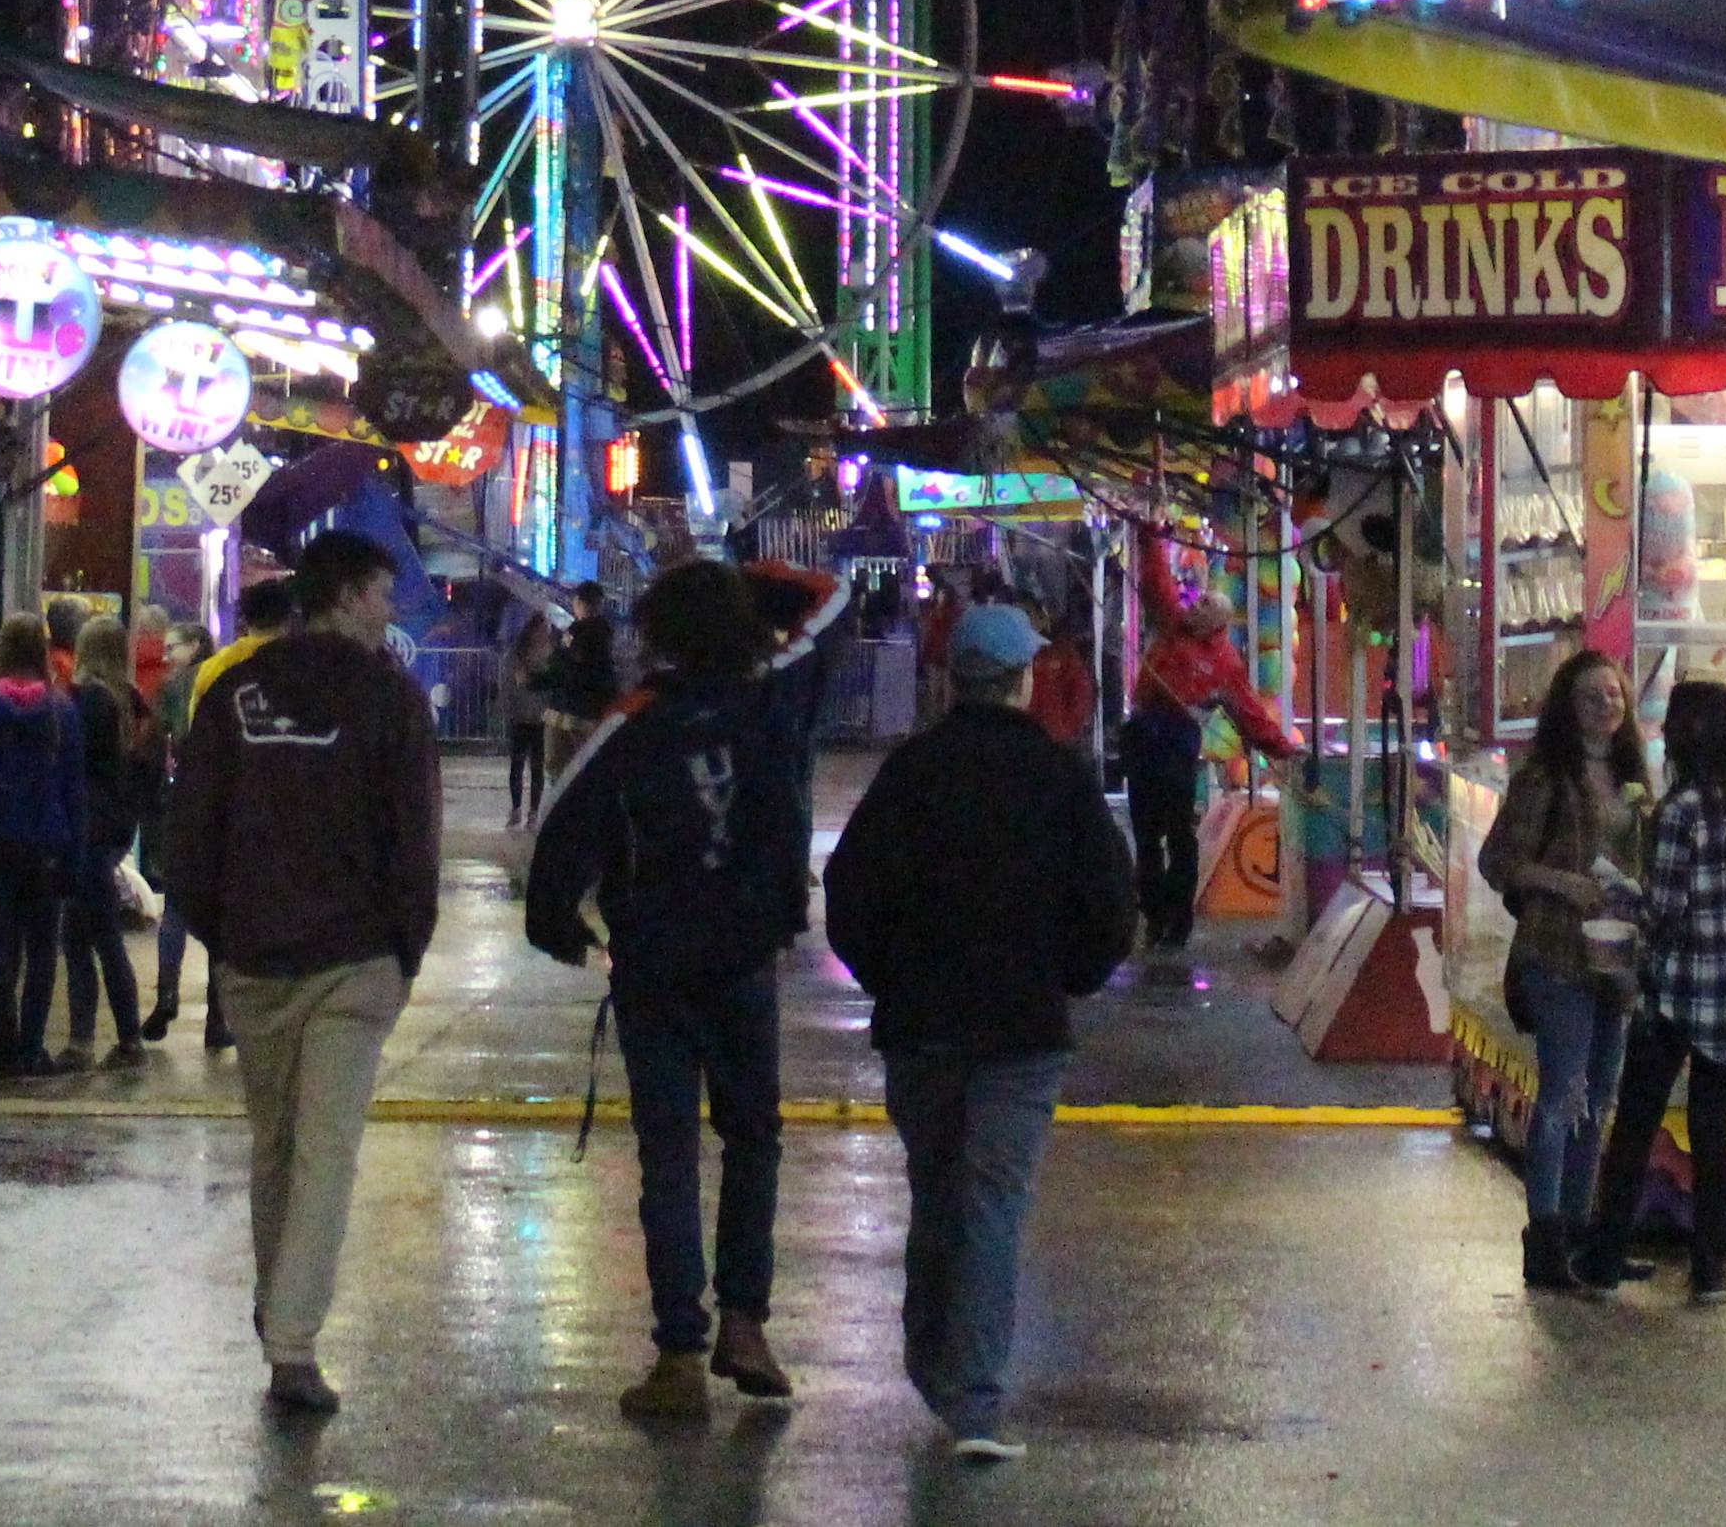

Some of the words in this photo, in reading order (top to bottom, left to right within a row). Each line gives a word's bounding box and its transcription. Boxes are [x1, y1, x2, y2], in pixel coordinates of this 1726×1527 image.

[1305, 175, 1419, 197] ICE
[1441, 169, 1627, 195] COLD
[1304, 196, 1628, 321] DRINKS
[209, 484, 242, 505] 25¢
